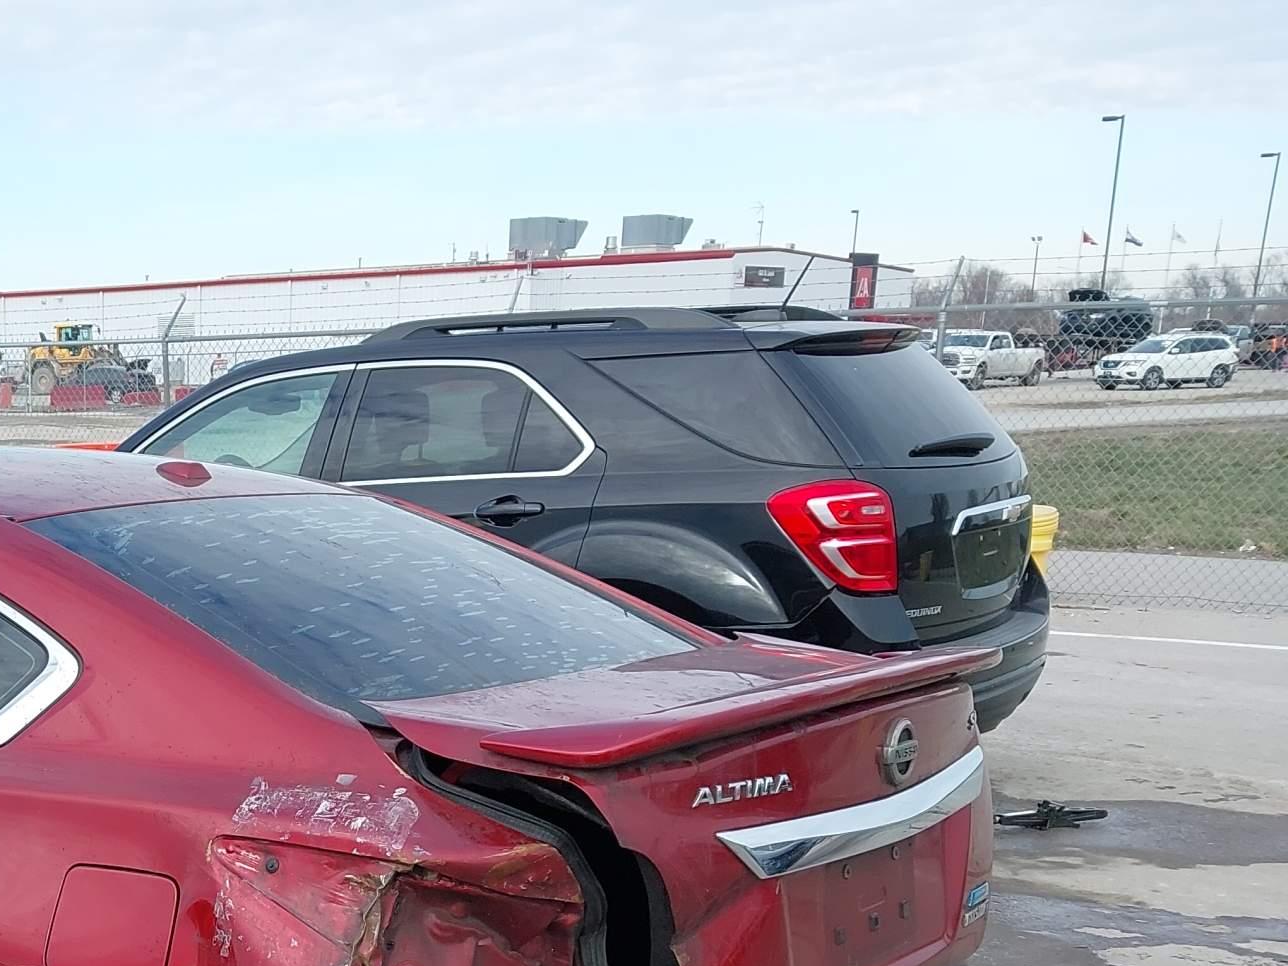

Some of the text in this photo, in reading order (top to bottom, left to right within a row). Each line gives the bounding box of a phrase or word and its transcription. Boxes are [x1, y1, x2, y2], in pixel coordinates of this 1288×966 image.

[905, 605, 943, 618] EQUINOX
[895, 745, 918, 760] NISS
[691, 772, 793, 808] ALTIMA
